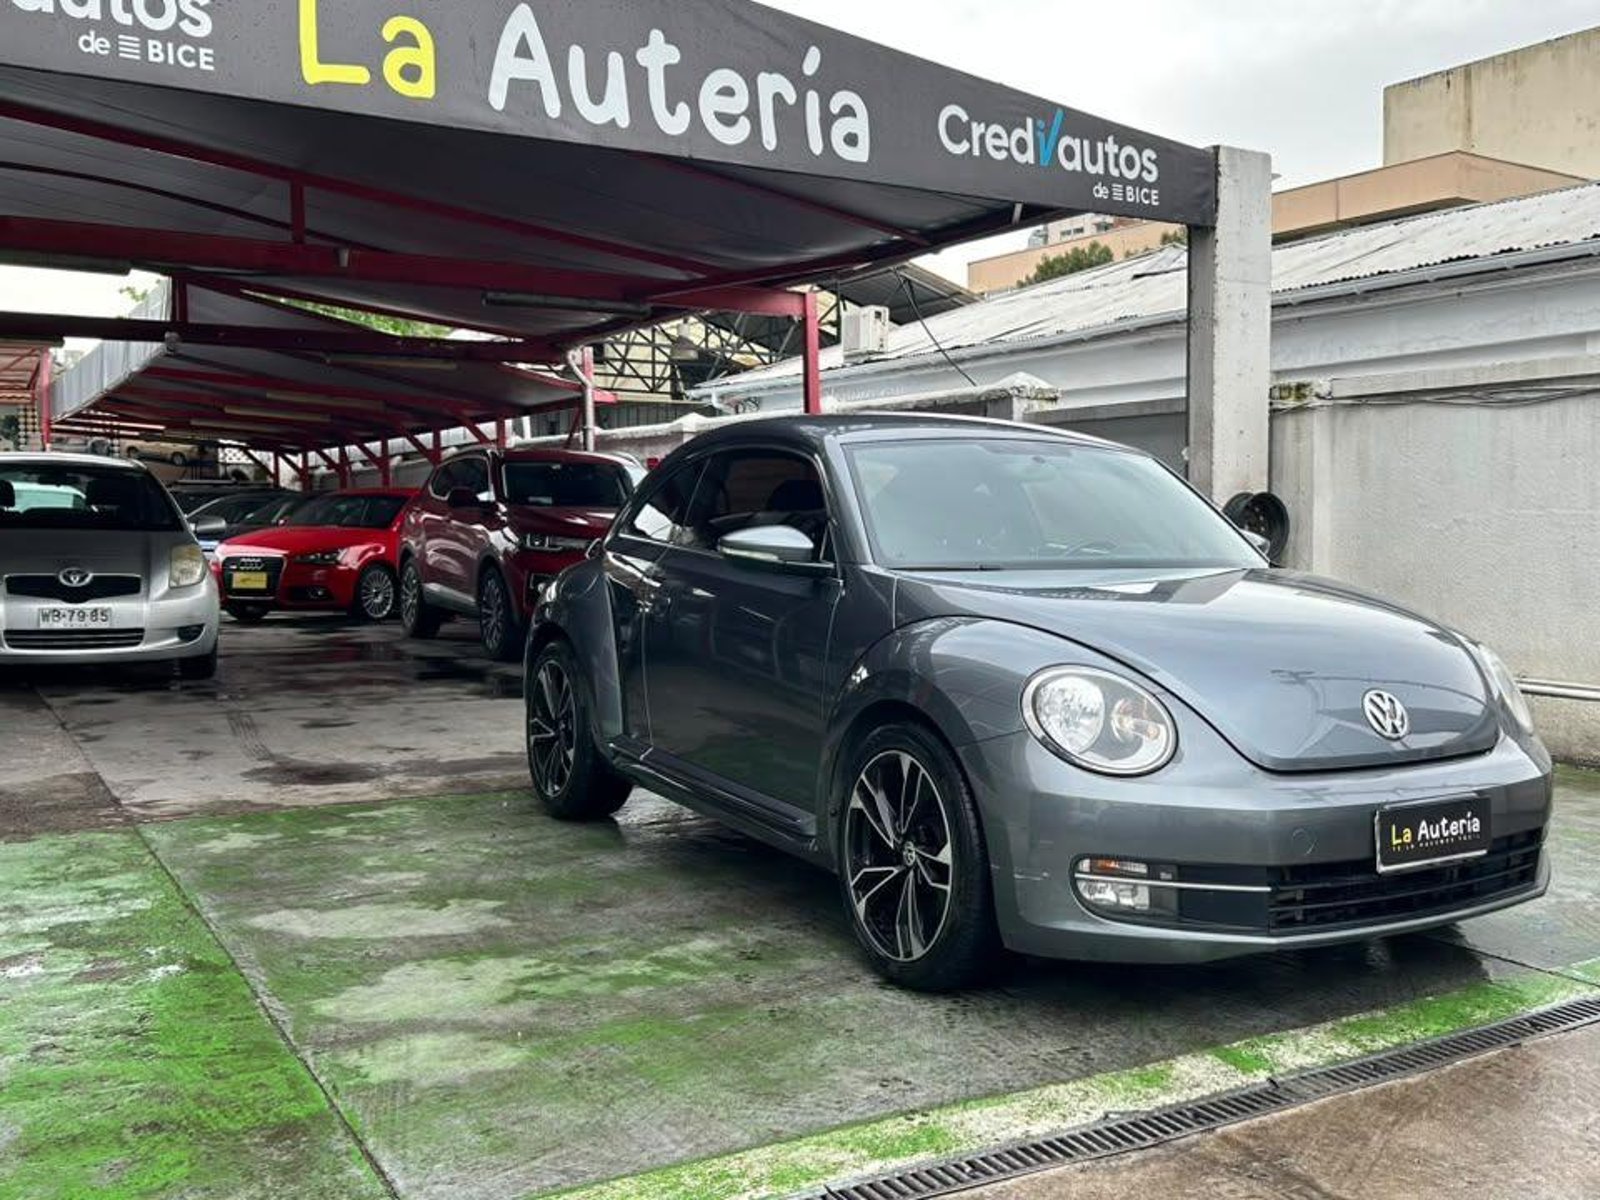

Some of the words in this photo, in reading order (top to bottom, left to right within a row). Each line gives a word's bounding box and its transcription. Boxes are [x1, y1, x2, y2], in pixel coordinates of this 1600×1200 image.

[78, 29, 111, 55] de
[147, 39, 215, 71] BICE
[299, 0, 436, 99] La
[488, 3, 869, 163] Autería
[1092, 181, 1109, 199] de
[1125, 185, 1160, 206] BICE
[1391, 824, 1412, 845] La
[1417, 811, 1480, 842] Autería
